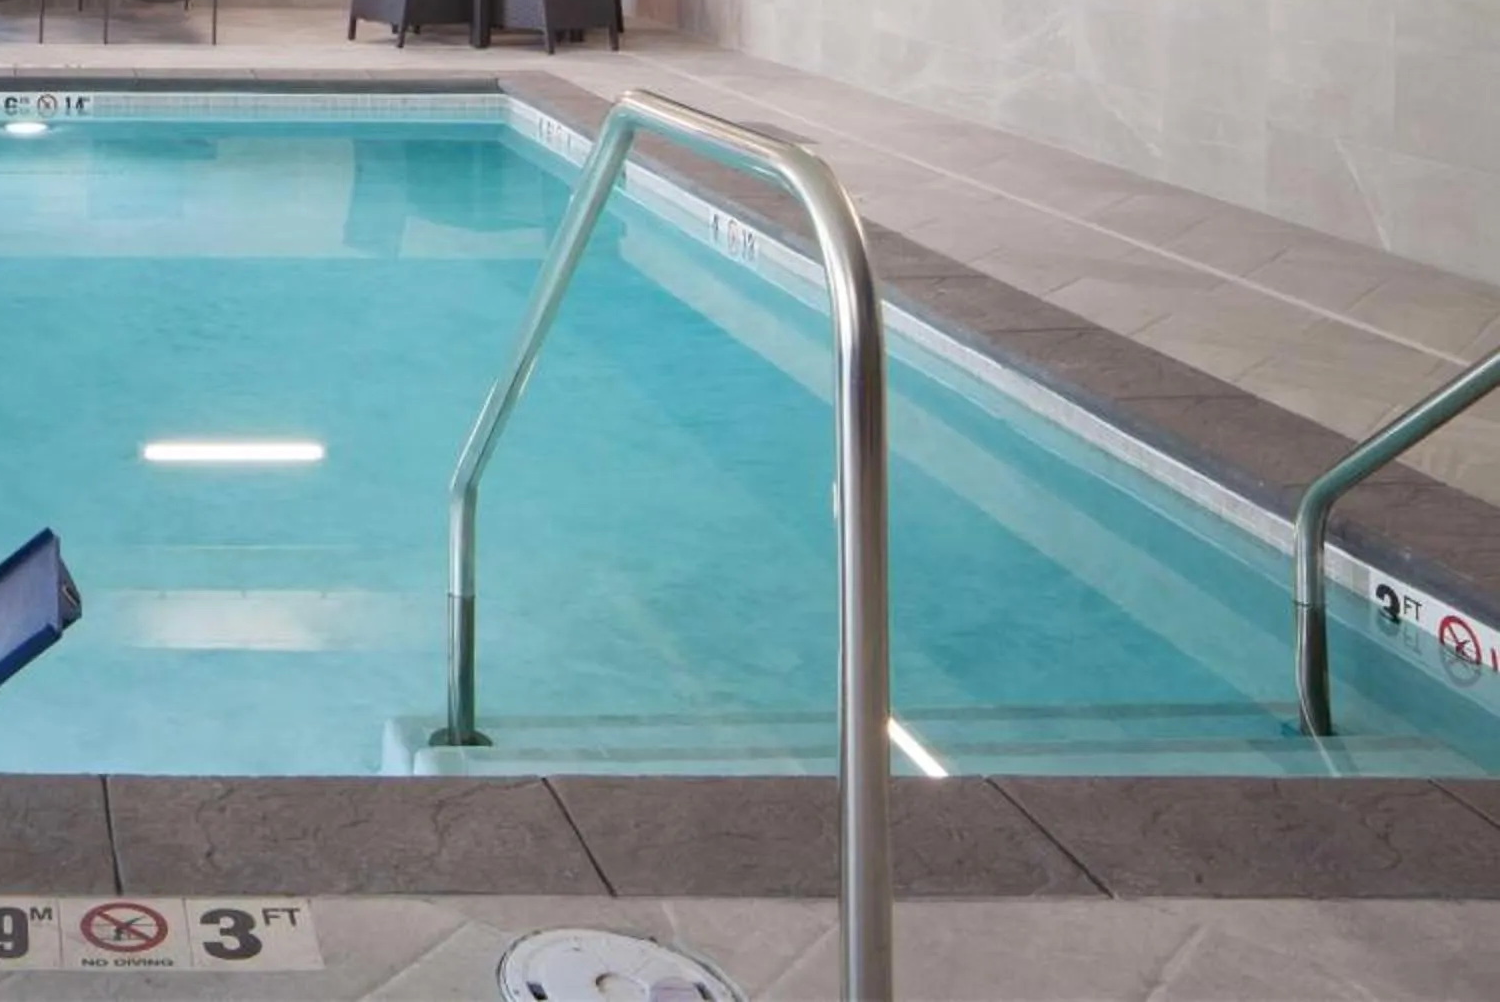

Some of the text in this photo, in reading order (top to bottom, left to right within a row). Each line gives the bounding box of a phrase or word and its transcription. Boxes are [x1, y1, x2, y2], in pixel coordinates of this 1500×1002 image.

[1404, 596, 1422, 620] FT
[81, 958, 175, 968] NO DIVING
